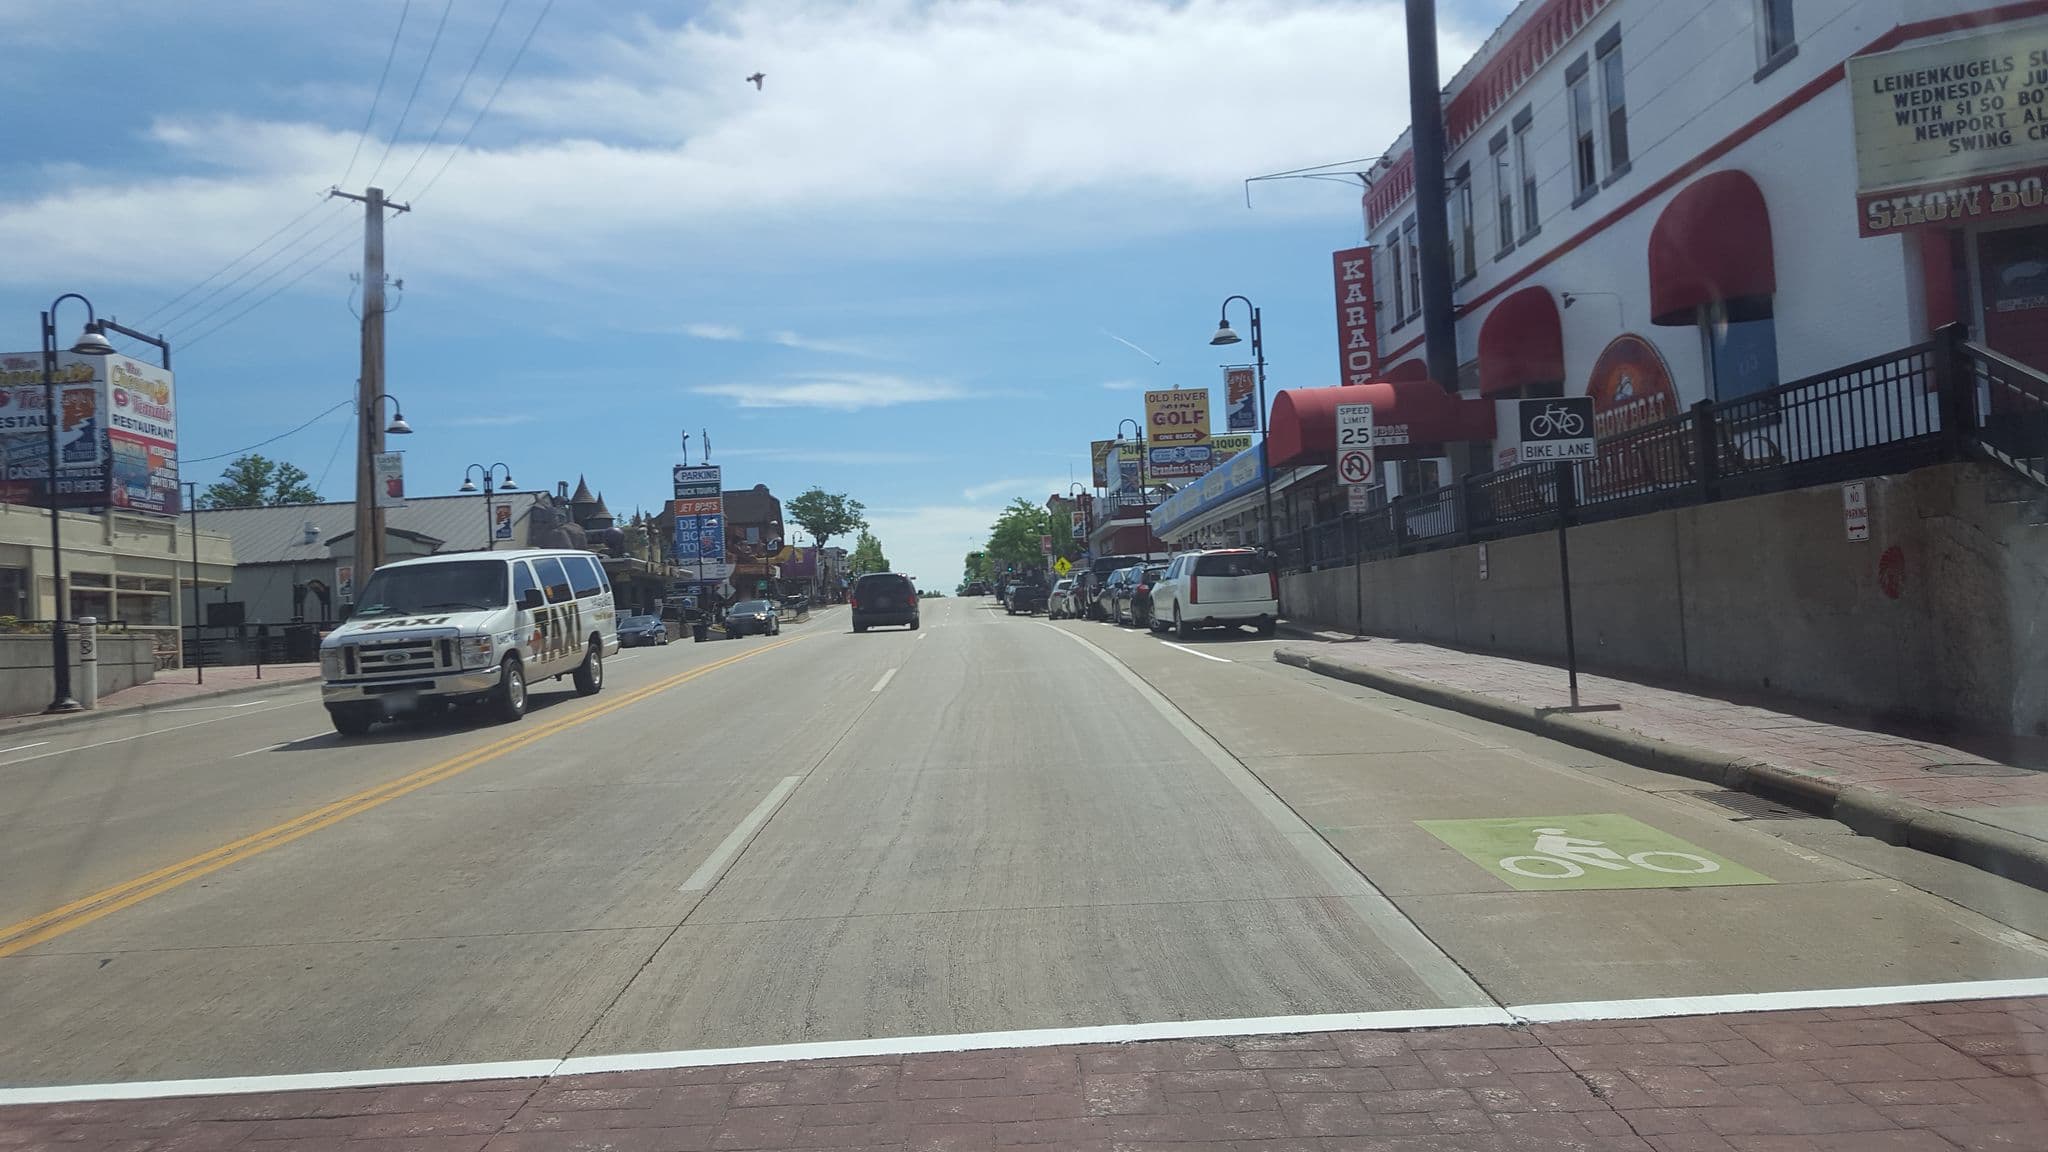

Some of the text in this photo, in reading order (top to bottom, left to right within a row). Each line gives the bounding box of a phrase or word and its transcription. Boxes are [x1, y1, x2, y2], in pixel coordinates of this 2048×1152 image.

[1873, 56, 2015, 94] LEINENKUGELS
[1893, 68, 2048, 108] WEDNESDAY JU
[1895, 106, 1943, 126] WITH
[1915, 112, 2008, 142] NEWPORT
[1948, 130, 2012, 154] SWING
[1867, 175, 2048, 231] SHOW BO
[1149, 392, 1207, 403] OLD RIVER
[1152, 410, 1204, 425] GOLF
[1339, 407, 1370, 415] SPEED
[112, 413, 175, 439] RESTAURANT
[1211, 438, 1249, 449] LIQUOR
[1341, 427, 1369, 444] 25
[1526, 445, 1552, 458] BIKE
[1559, 443, 1592, 457] LANE
[681, 470, 718, 480] PARKING
[368, 616, 451, 630] TAXI
[533, 602, 582, 664] TAXI
